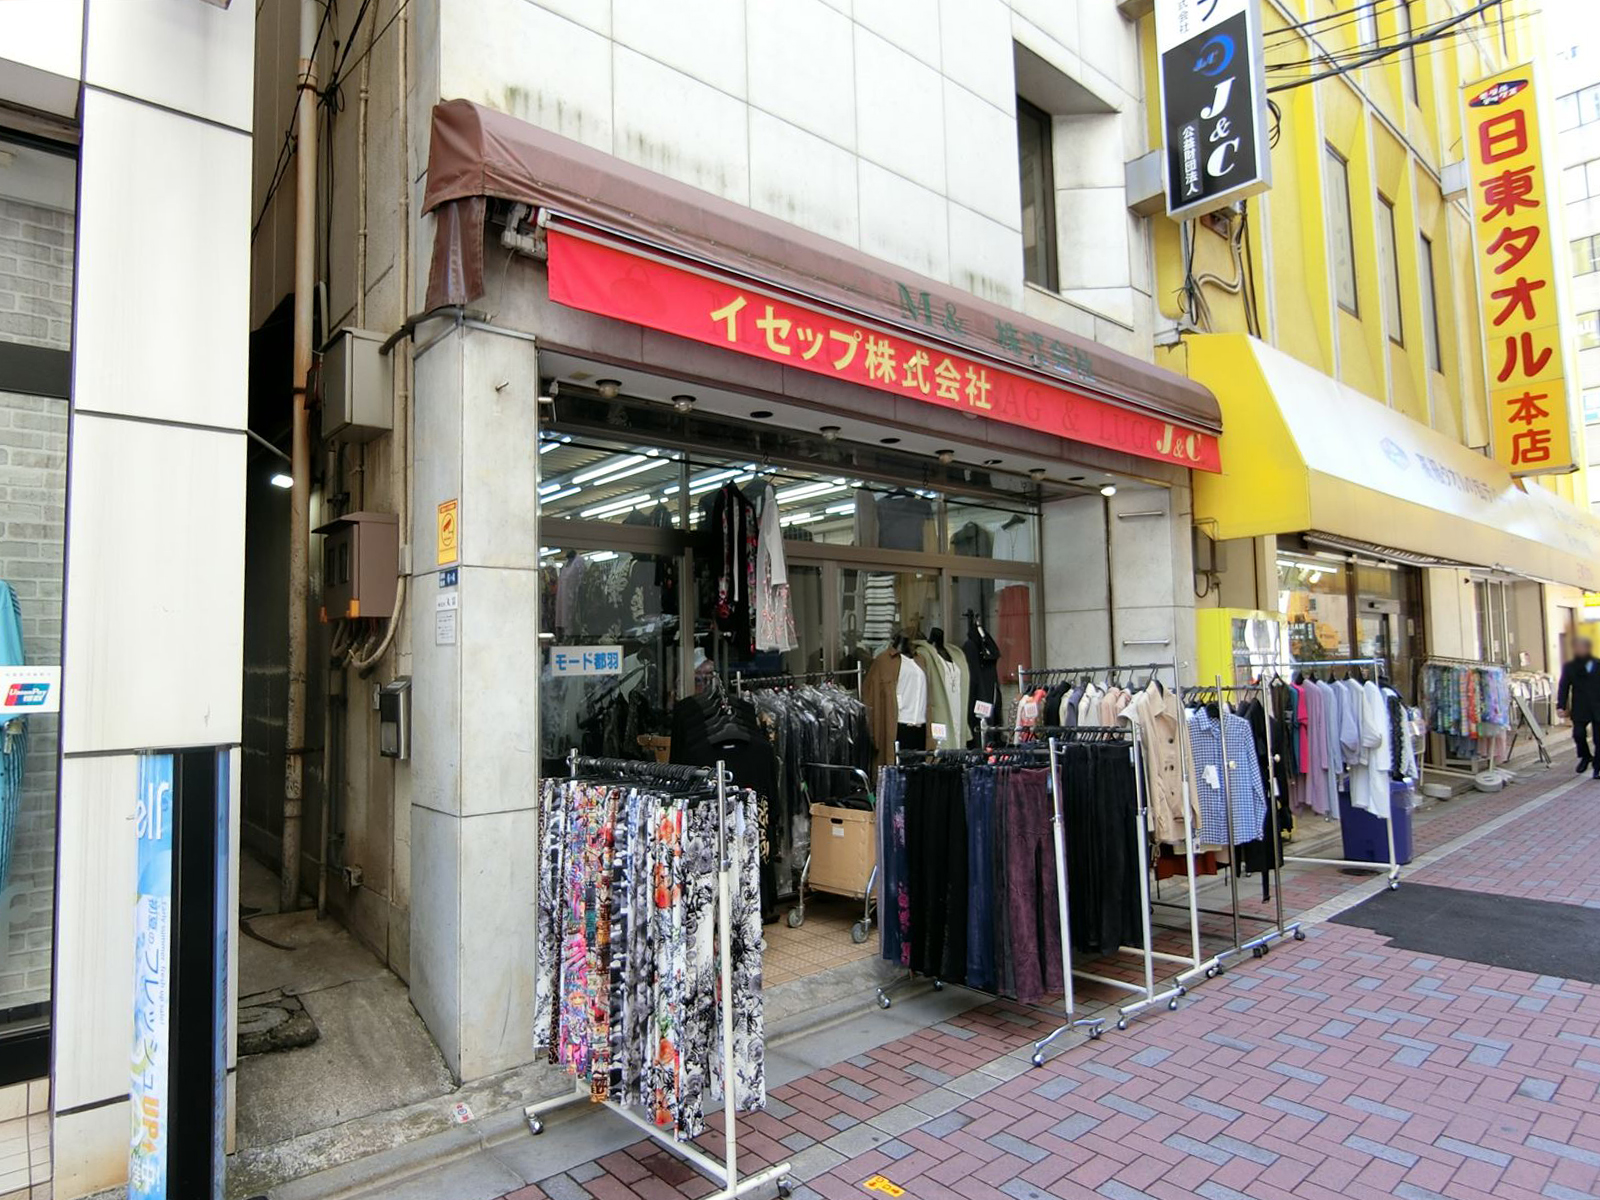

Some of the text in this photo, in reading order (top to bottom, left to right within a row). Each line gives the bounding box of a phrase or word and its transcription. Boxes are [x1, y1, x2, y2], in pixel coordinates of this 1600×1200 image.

[710, 296, 992, 409] イセップ株式会社
